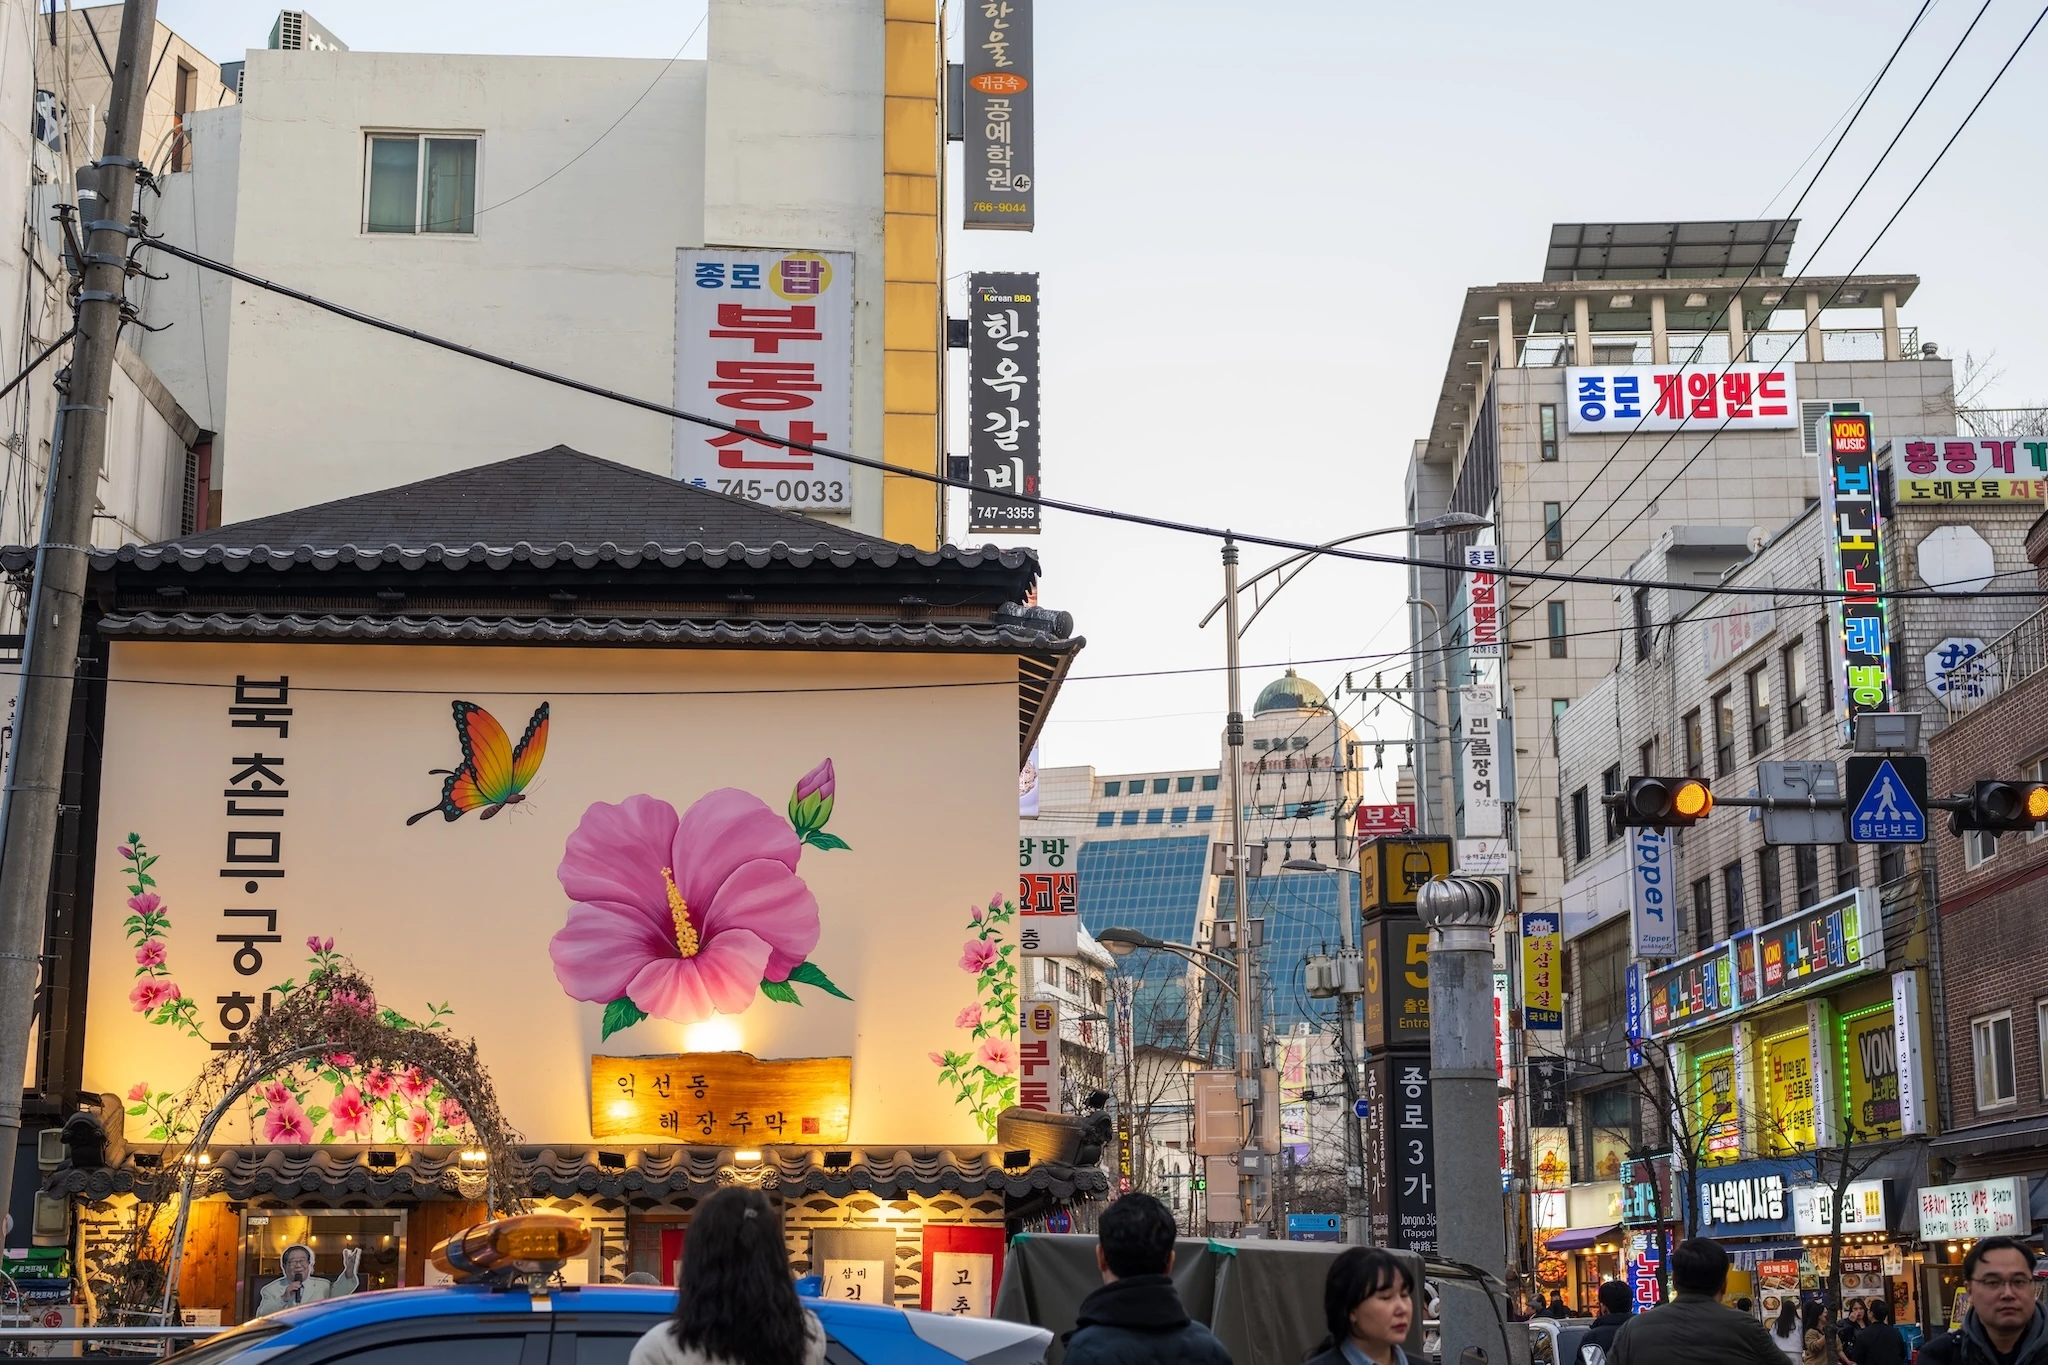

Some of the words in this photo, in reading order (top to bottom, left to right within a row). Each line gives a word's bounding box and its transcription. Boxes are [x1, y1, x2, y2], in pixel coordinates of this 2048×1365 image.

[979, 76, 1019, 90] 귀금속
[984, 98, 1014, 191] 공예학원
[1014, 177, 1030, 188] 4F
[973, 202, 1026, 213] 766-9044
[694, 261, 761, 289] 종로
[780, 255, 826, 295] 탑
[984, 294, 1012, 303] Korean
[1013, 294, 1032, 303] BBQ
[704, 303, 828, 471] 부동산
[1578, 376, 1641, 422] 종로
[1653, 372, 1788, 420] 게임랜드
[982, 309, 1030, 496] 한옥갈비
[1833, 423, 1866, 437] VONO
[1835, 438, 1866, 450] MUSIC
[717, 479, 843, 502] 745-0033
[1911, 481, 2001, 499] 노래무료
[977, 507, 1035, 519] 747-3355
[1469, 550, 1496, 567] 종로
[1471, 571, 1497, 643] 게임랜드
[1469, 717, 1492, 798] 민물장어
[1364, 806, 1411, 829] 보석
[1858, 823, 1919, 838] 횡단보도
[1636, 826, 1666, 923] ipper
[1531, 924, 1550, 932] 24시
[1643, 934, 1671, 942] Zipper
[1404, 933, 1431, 989] 5
[1764, 943, 1780, 965] VONO
[1367, 939, 1379, 994] 5
[1766, 963, 1782, 982] MUSIC
[1533, 952, 1554, 1007] 삼겹살
[1034, 1009, 1052, 1030] 탑
[1529, 1011, 1558, 1022] 국내산
[617, 1073, 710, 1099] 익선동
[659, 1110, 787, 1136] 해장주막
[1400, 1066, 1432, 1204] 종로3가
[1819, 1193, 1856, 1225] 만집
[1971, 1188, 1988, 1215] 냉면
[1401, 1213, 1425, 1228] Jongno
[1402, 1229, 1435, 1239] (Tapgol
[18, 1264, 48, 1274] 로켓프레시
[842, 1267, 867, 1280] 삼미
[29, 1290, 59, 1299] 로켓프레시
